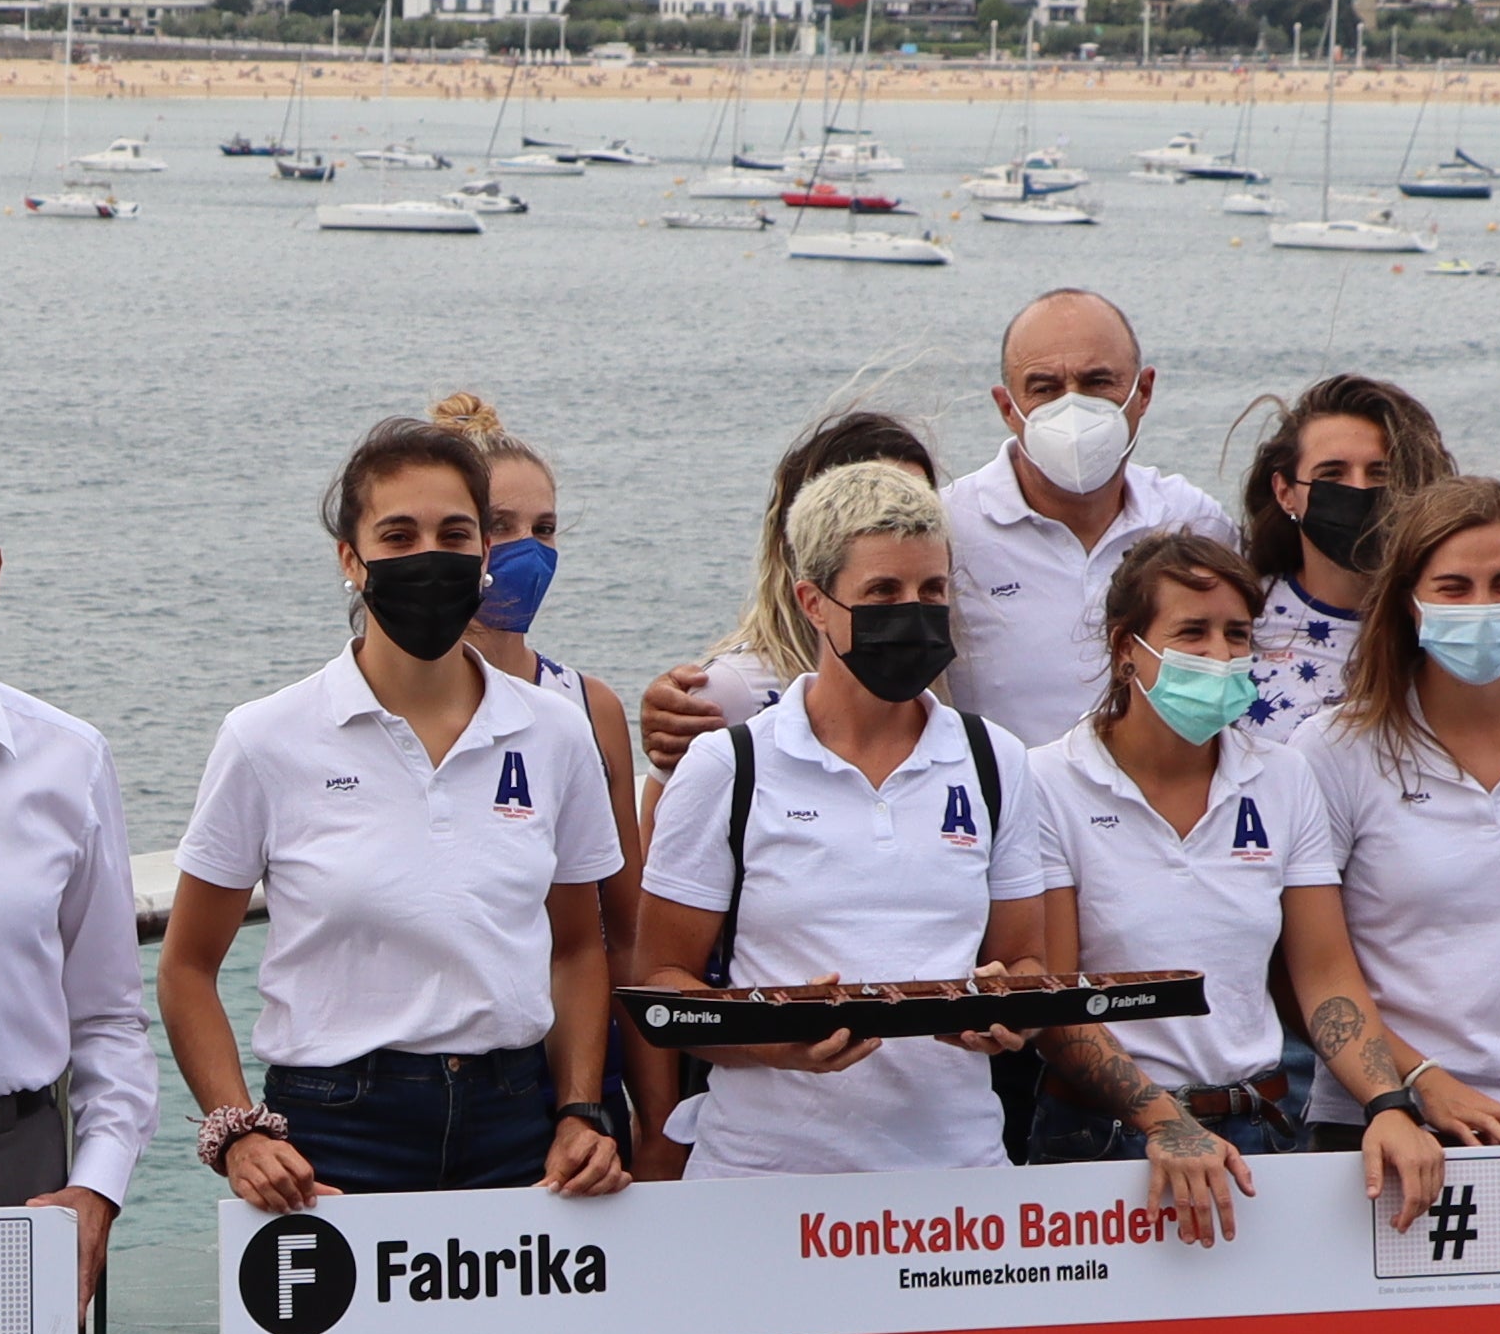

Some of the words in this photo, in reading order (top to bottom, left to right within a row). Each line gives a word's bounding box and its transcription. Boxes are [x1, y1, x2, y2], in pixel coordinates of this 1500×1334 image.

[494, 751, 532, 808] A
[672, 1010, 722, 1024] Fabrika
[1110, 993, 1157, 1009] Fabrika
[801, 1206, 1003, 1259] Kontxako
[1427, 1185, 1478, 1261] #
[376, 1233, 607, 1303] Fabrika
[899, 1263, 1051, 1289] Emakumezkoen
[1056, 1259, 1108, 1283] maila
